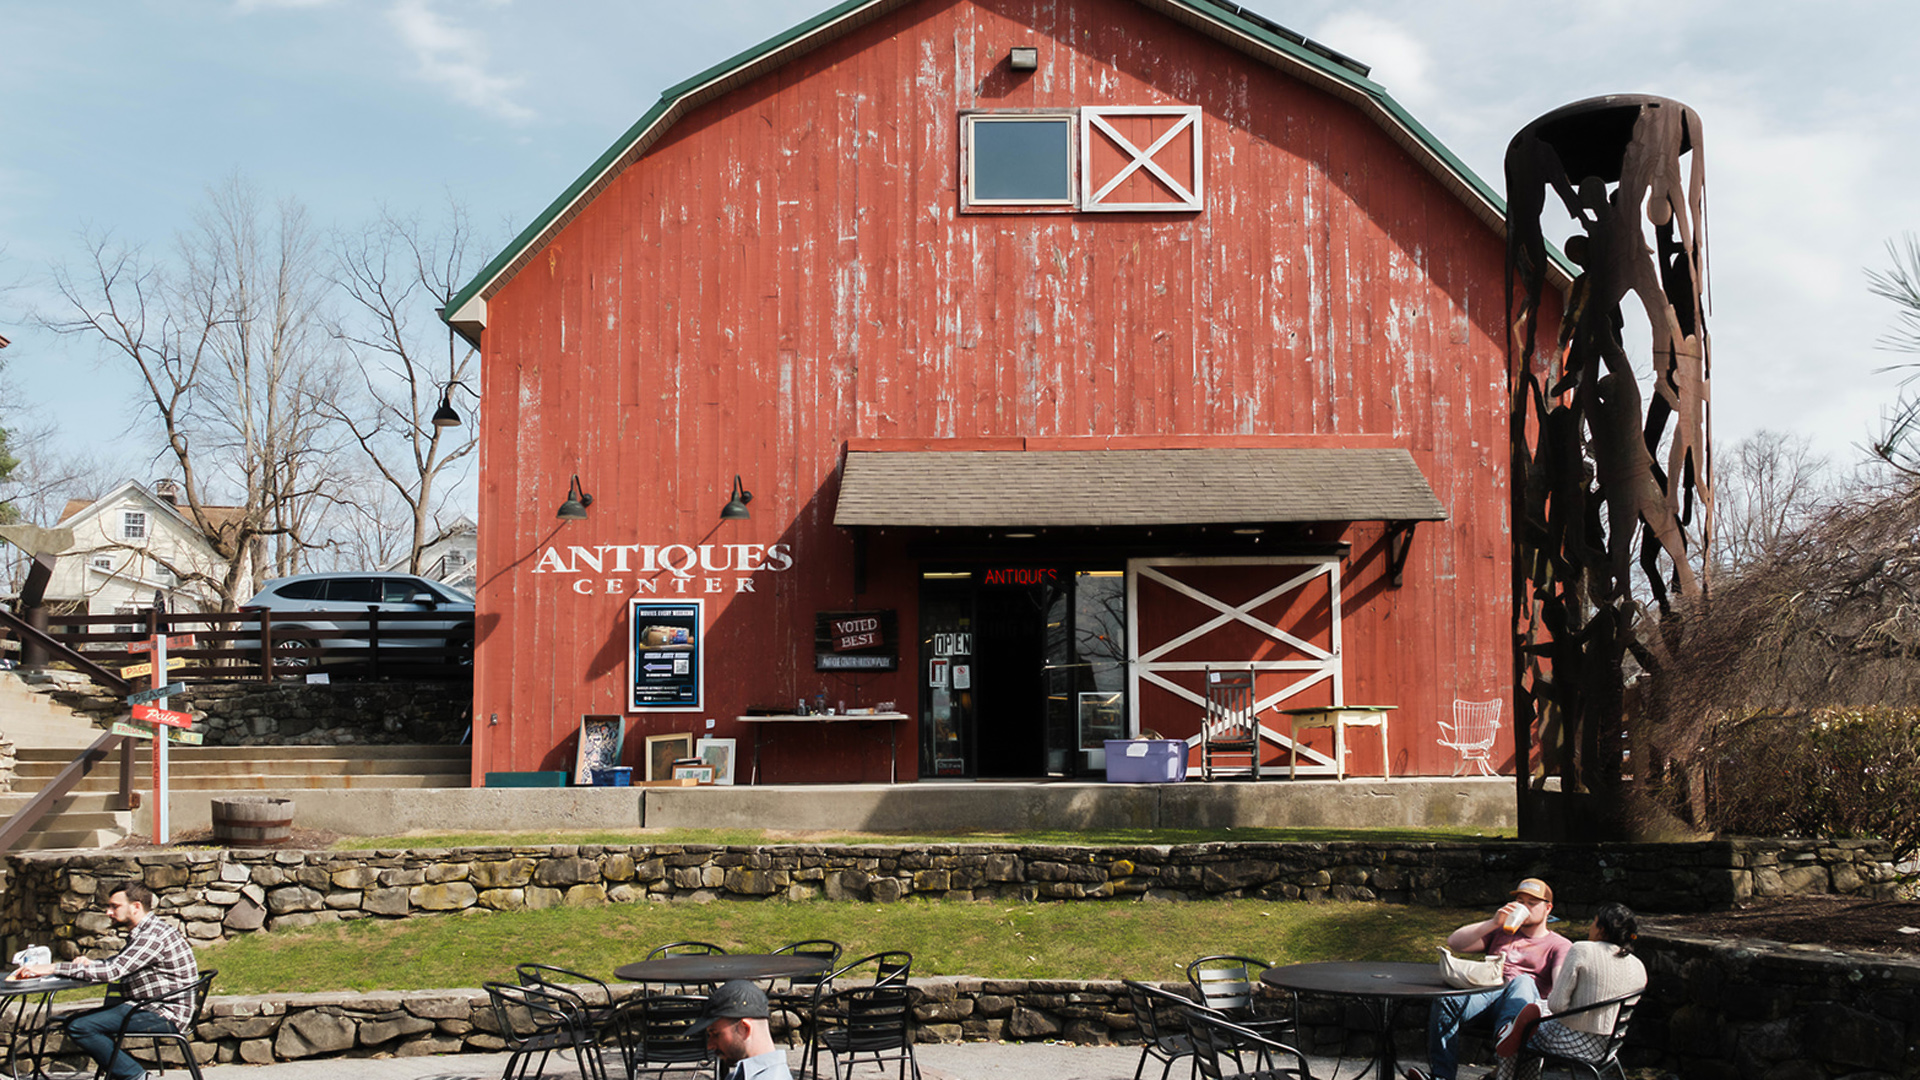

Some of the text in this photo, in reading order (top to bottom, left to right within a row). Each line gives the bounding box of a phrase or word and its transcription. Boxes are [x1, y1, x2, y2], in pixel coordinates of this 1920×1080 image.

[531, 543, 793, 578] ANTIQUES
[984, 568, 1058, 585] ANTIQUES
[573, 578, 757, 595] CENTER
[836, 618, 878, 633] VOTED
[841, 633, 875, 648] BEST
[936, 633, 971, 655] OPEN
[133, 686, 172, 703] PEACE
[145, 708, 180, 724] Paix
